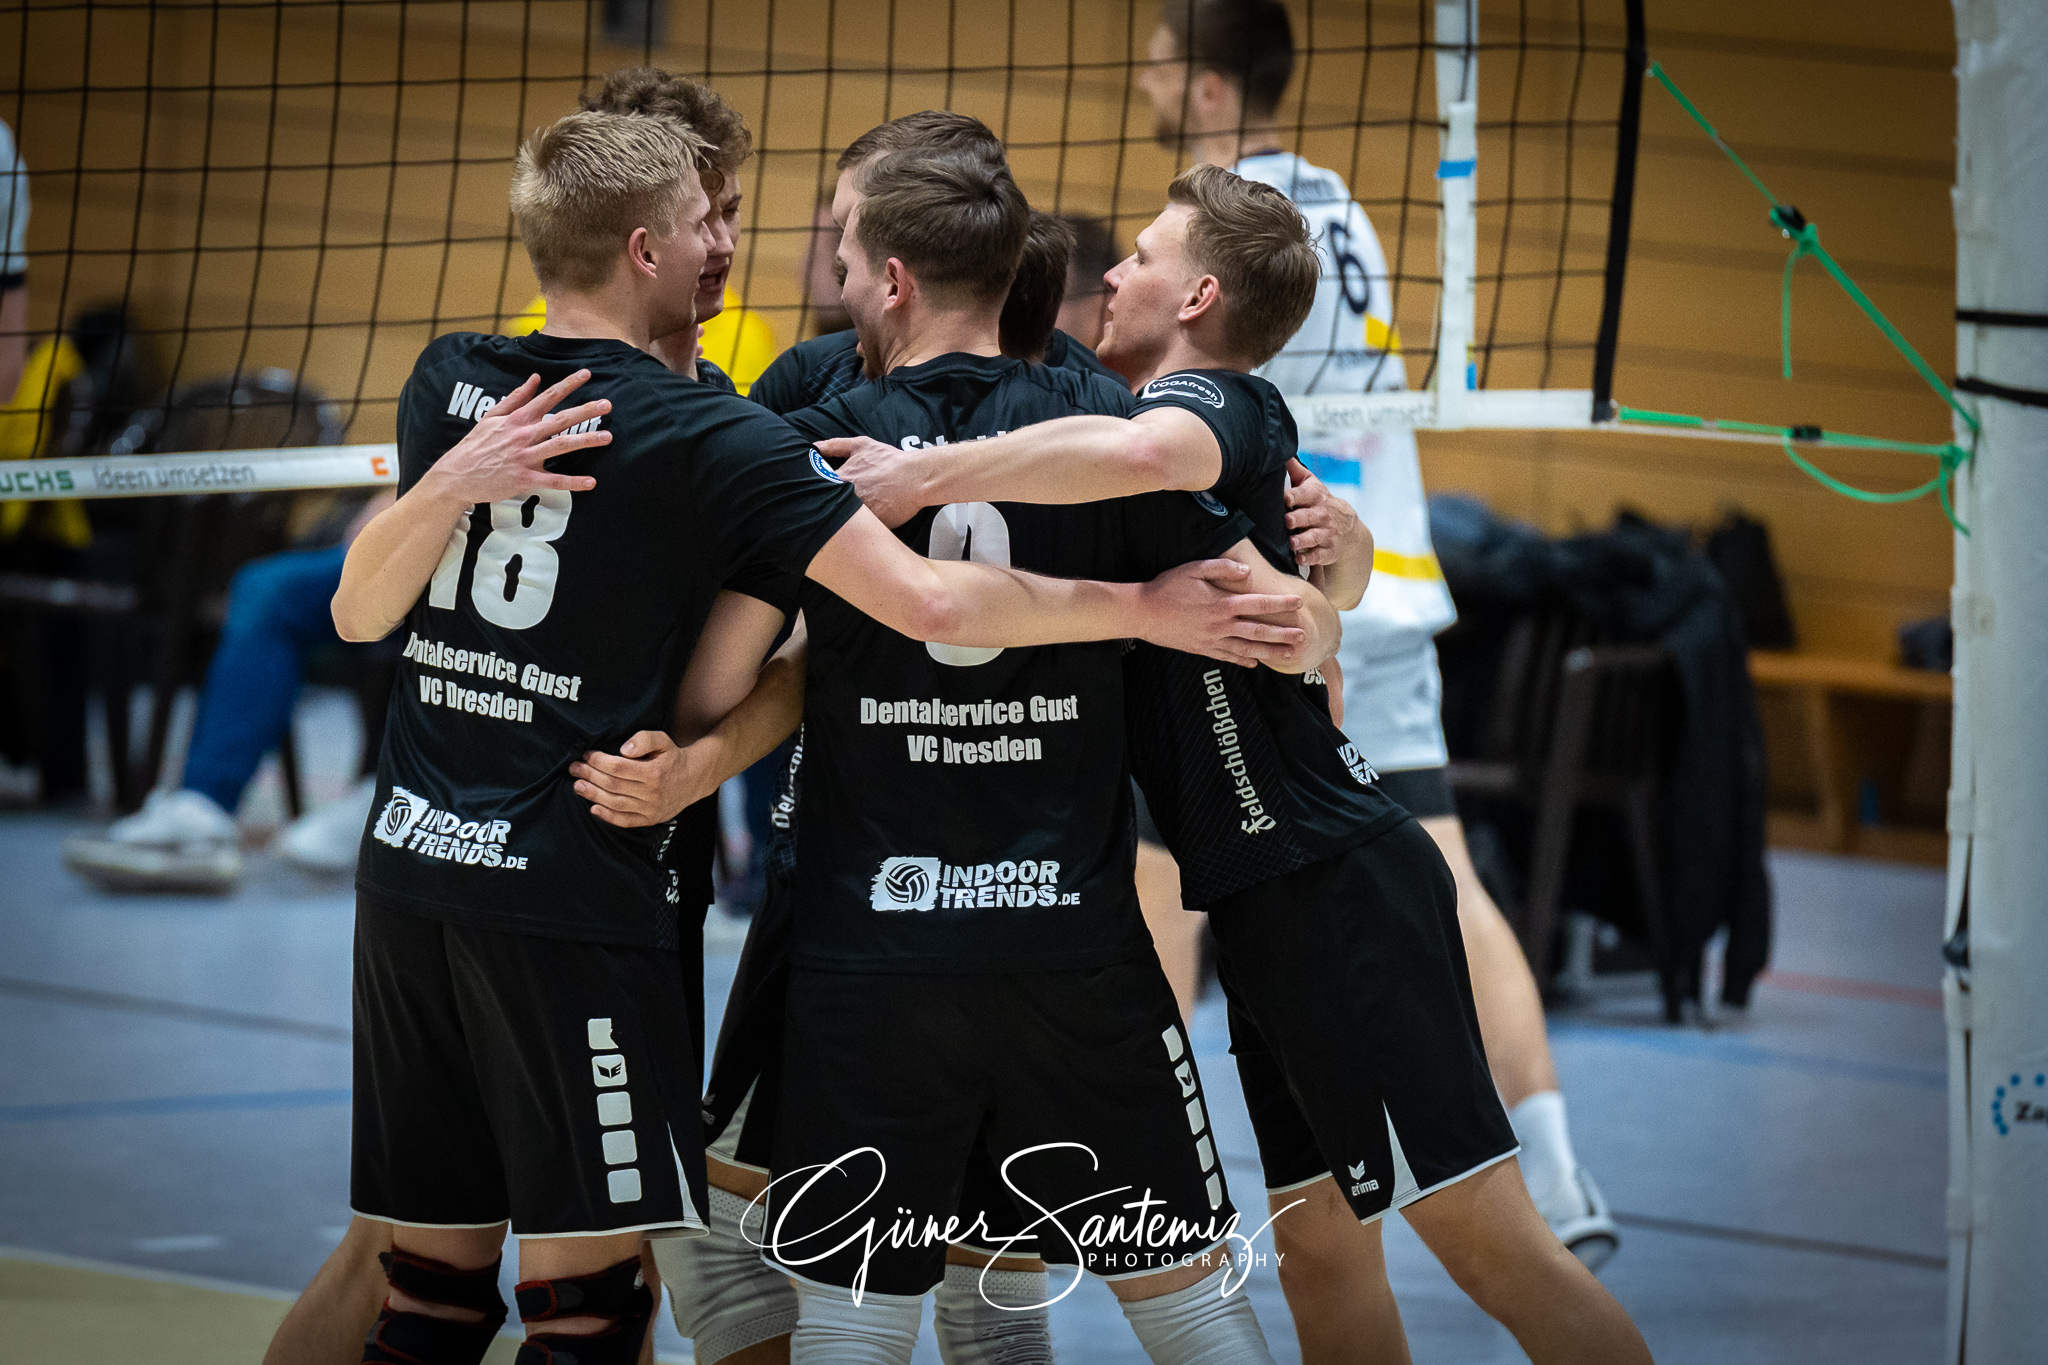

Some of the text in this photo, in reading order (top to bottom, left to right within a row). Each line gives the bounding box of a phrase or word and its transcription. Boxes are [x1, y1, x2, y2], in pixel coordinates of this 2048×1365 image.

[1328, 221, 1371, 316] 6
[1151, 379, 1218, 402] YOGAfresh
[0, 463, 257, 493] UCHS Ideen umsetzen
[428, 488, 573, 630] 18
[402, 631, 582, 702] Dntalservice Gust
[419, 675, 534, 723] VC Dresden
[860, 694, 1079, 727] Dentalservice Gust
[906, 734, 1042, 765] VC Dresden
[1203, 668, 1277, 834] Feldschlößchen
[418, 808, 512, 843] INDOOR
[407, 827, 529, 870] TRENDS.DE
[941, 860, 1060, 888] INDOOR
[939, 884, 1081, 909] TRENDS.DE
[2015, 1101, 2048, 1124] Za
[1352, 1179, 1380, 1197] erima
